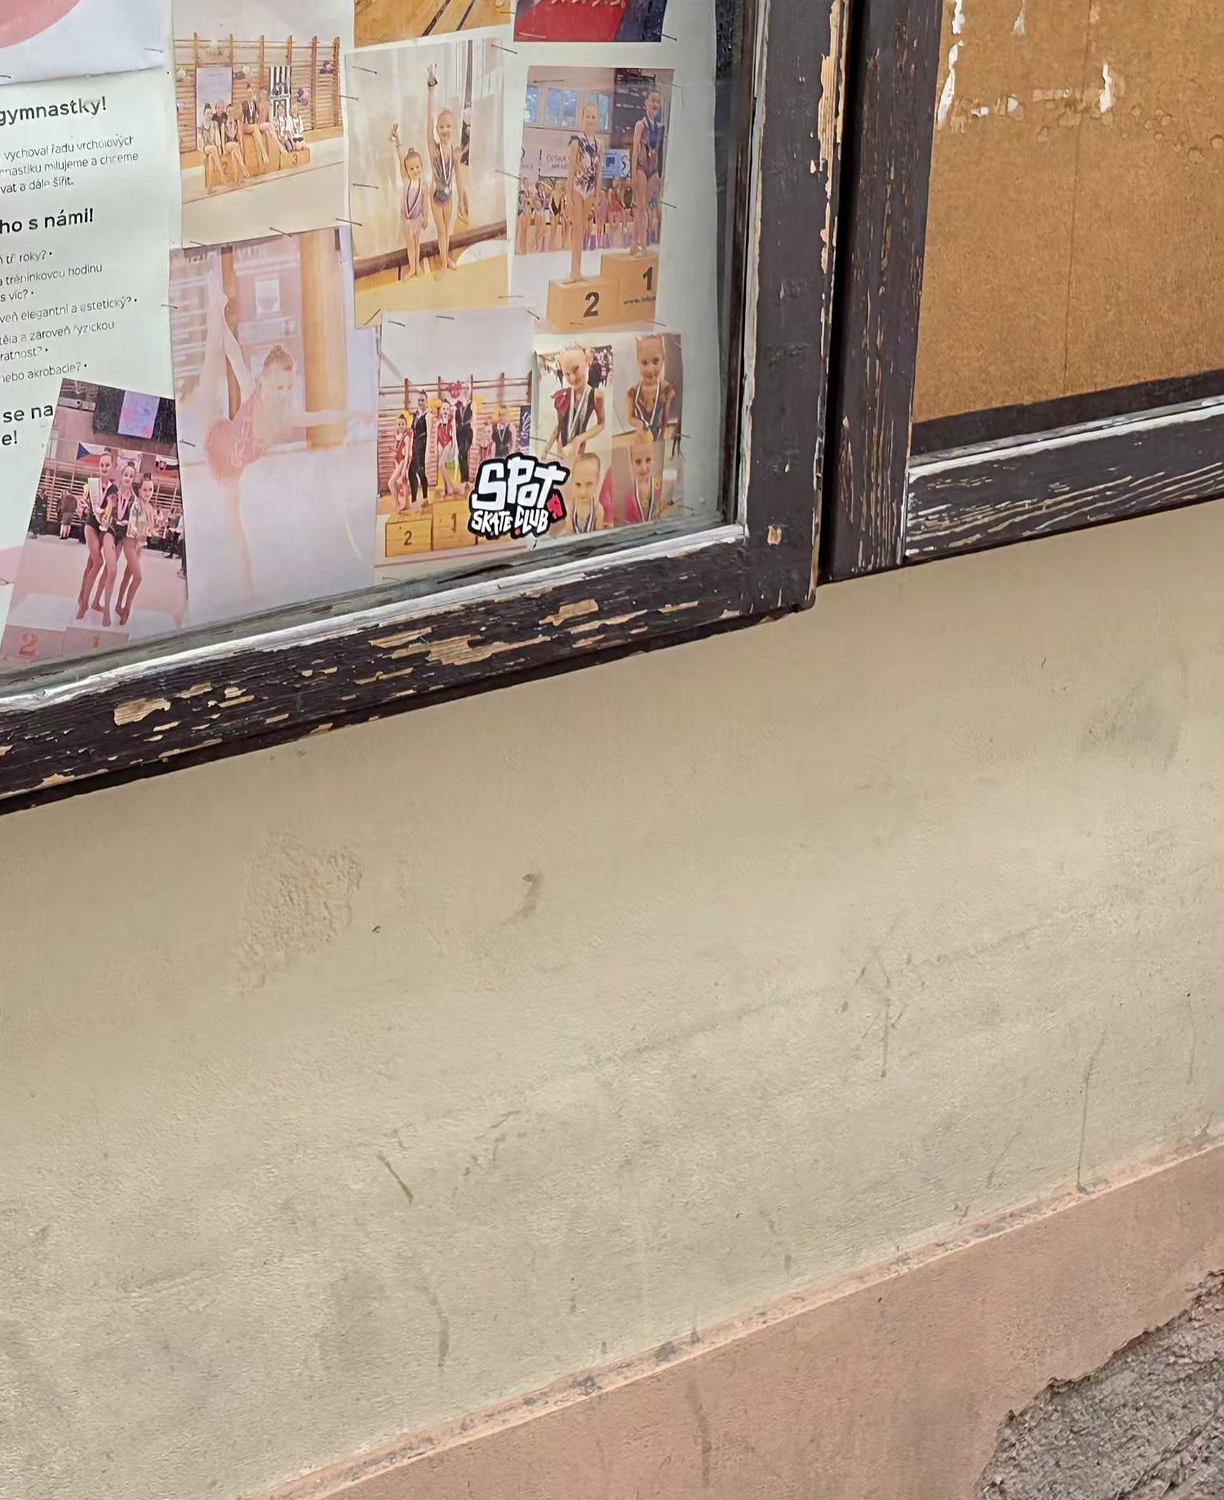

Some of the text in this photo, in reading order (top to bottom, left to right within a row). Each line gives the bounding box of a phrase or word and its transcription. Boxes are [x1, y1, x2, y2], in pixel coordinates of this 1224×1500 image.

[4, 145, 48, 162] vychoval
[44, 158, 89, 172] milujeme
[91, 157, 97, 165] a
[100, 152, 139, 166] chceme
[20, 183, 26, 192] a
[28, 218, 38, 230] s
[44, 208, 94, 228] námi!
[19, 250, 47, 264] roky?
[68, 264, 103, 276] hodinu
[642, 266, 653, 291] 1
[8, 289, 28, 301] víc?
[71, 304, 77, 313] a
[583, 292, 600, 318] 2
[20, 333, 26, 342] a
[27, 361, 82, 380] akrobacie?
[3, 409, 25, 423] se
[31, 404, 54, 419] na
[471, 456, 567, 511] SPOT
[471, 506, 549, 536] SKATE CLUB
[404, 531, 412, 545] 2
[18, 633, 38, 657] 2
